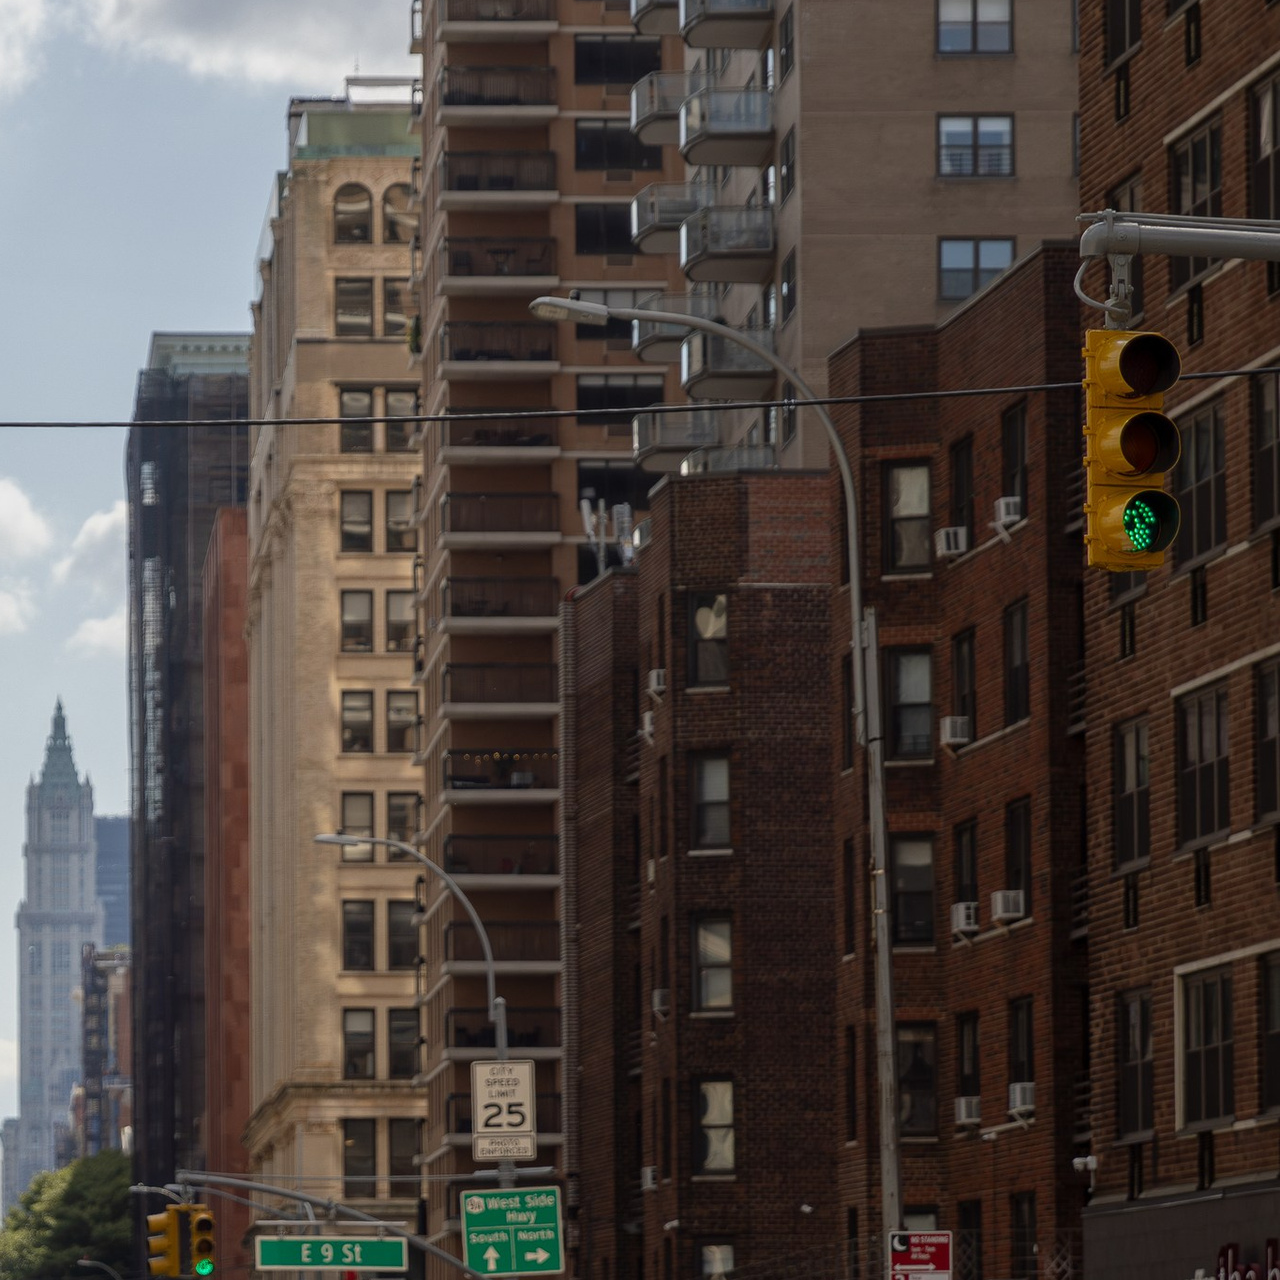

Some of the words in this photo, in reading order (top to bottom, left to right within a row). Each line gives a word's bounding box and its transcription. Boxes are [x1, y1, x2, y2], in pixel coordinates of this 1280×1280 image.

[489, 1067, 514, 1075] CITY
[485, 1078, 520, 1086] SPEED
[488, 1089, 517, 1098] LIMIT
[483, 1102, 526, 1128] 25
[486, 1196, 521, 1209] West
[524, 1194, 556, 1208] Side
[506, 1210, 537, 1225] Hwy
[470, 1231, 509, 1243] South
[517, 1228, 555, 1241] North
[301, 1243, 312, 1263] E
[320, 1243, 334, 1264] 9
[341, 1243, 363, 1264] St
